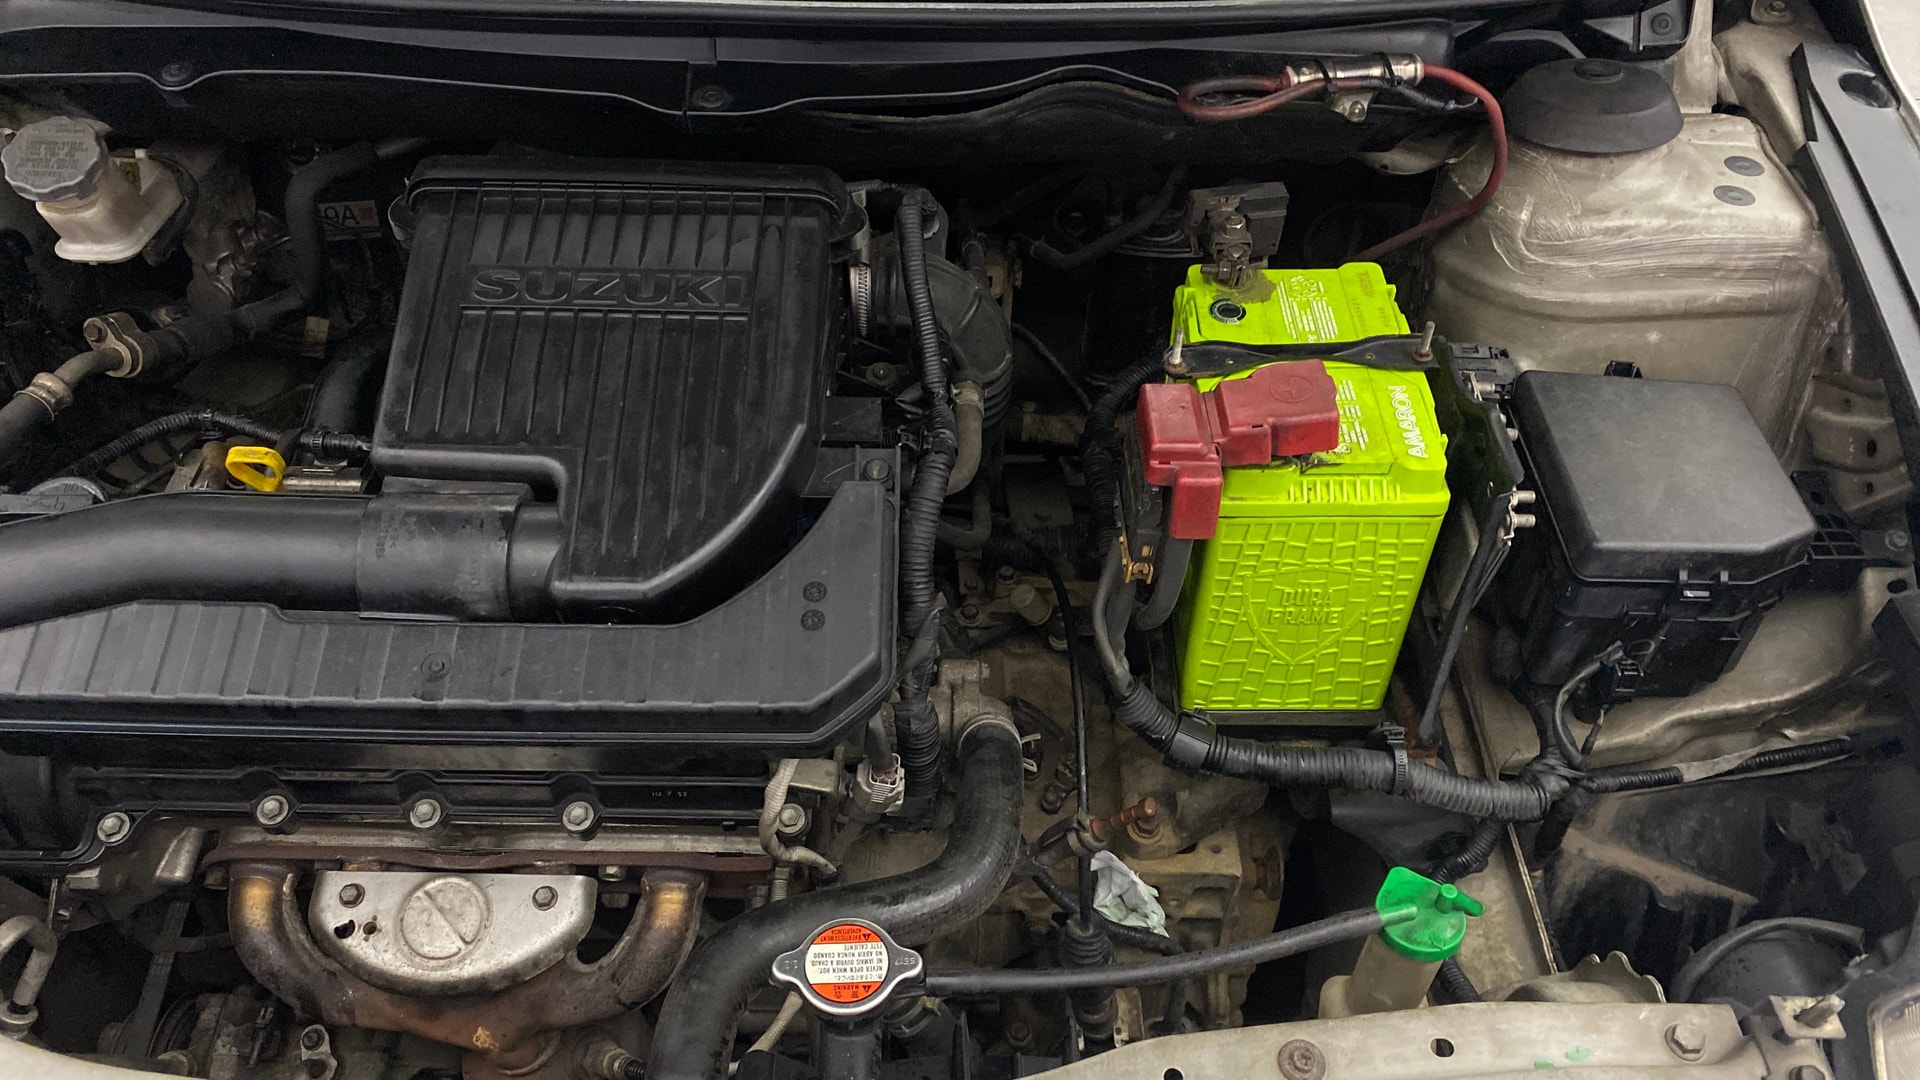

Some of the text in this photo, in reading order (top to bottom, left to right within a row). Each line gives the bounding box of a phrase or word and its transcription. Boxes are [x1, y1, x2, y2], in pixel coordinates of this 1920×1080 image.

[472, 270, 744, 306] SUZUKI
[1388, 386, 1429, 458] AMARON
[1281, 589, 1333, 606] DURA
[1268, 607, 1344, 624] FRAME
